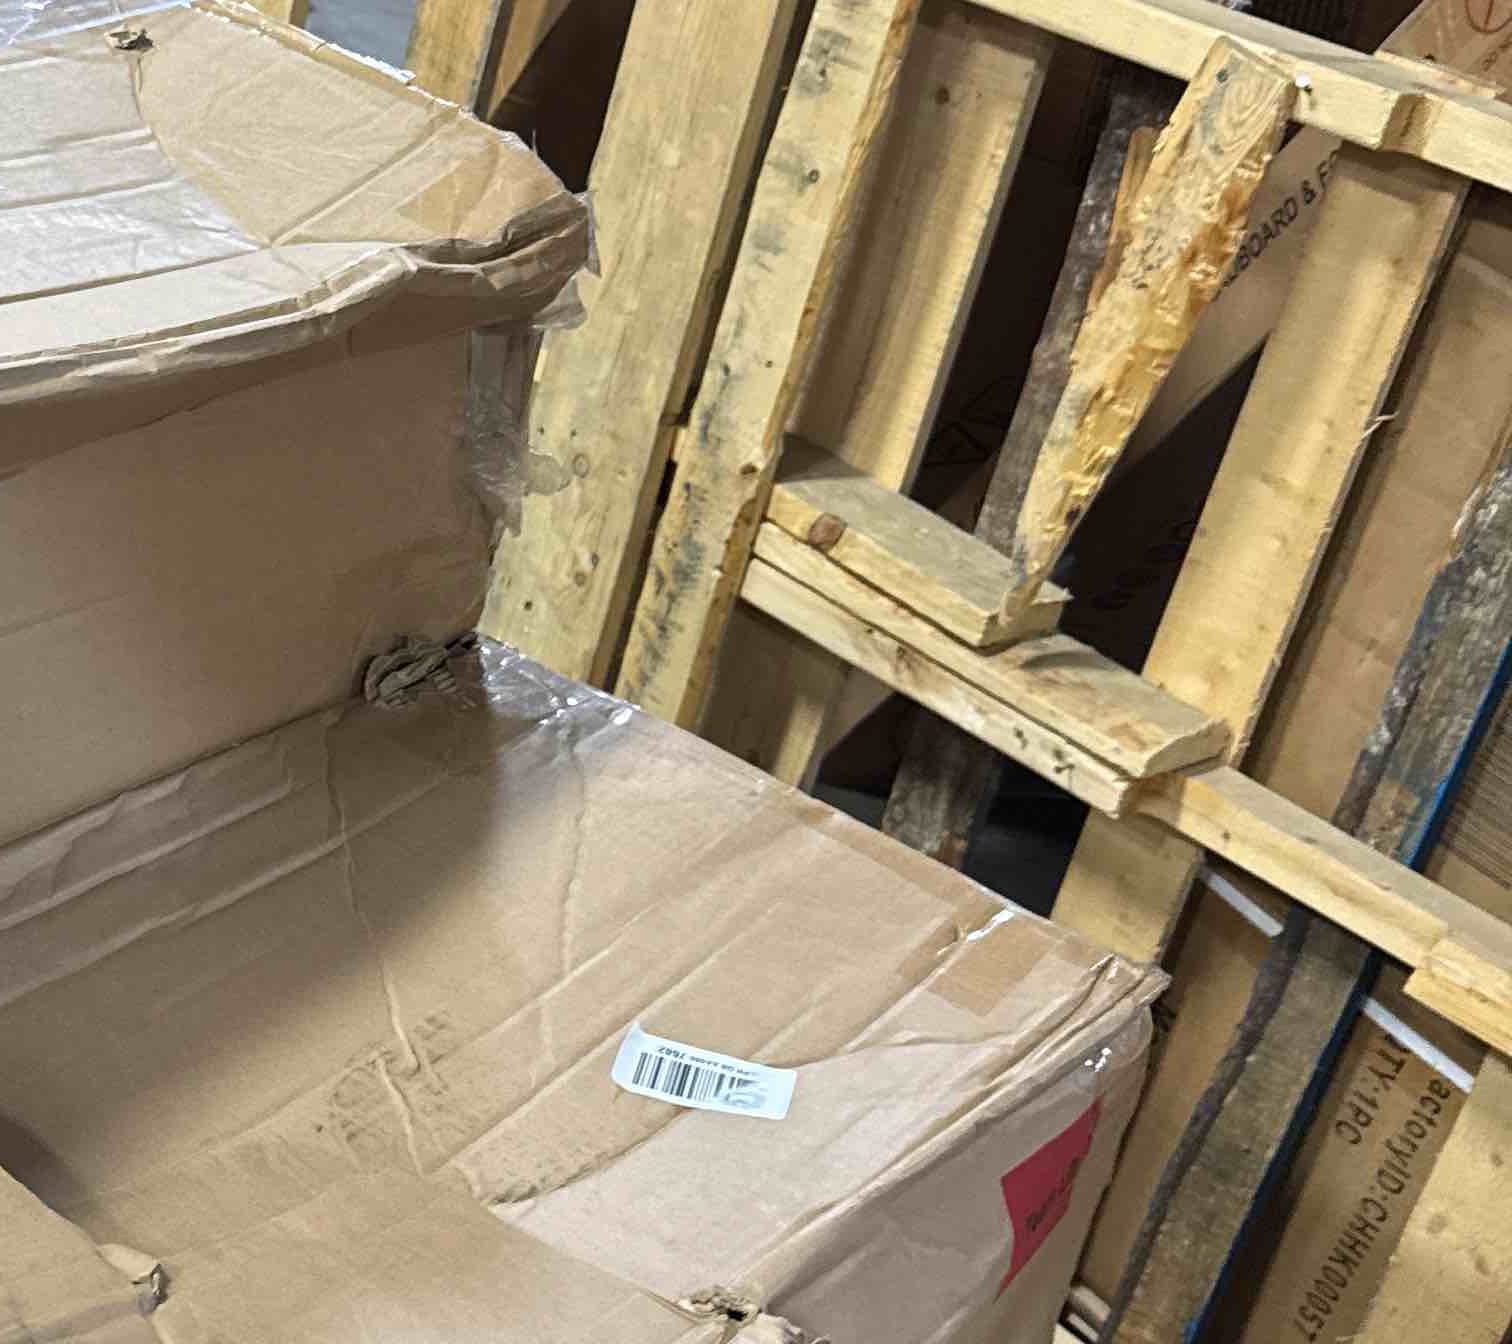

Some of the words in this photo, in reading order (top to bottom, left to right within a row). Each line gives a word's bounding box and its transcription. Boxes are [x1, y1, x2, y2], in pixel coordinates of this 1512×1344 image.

[1301, 180, 1317, 205] &
[1336, 1036, 1410, 1146] TY:1PC
[1295, 1078, 1451, 1344] actoryID:CHHK00057
